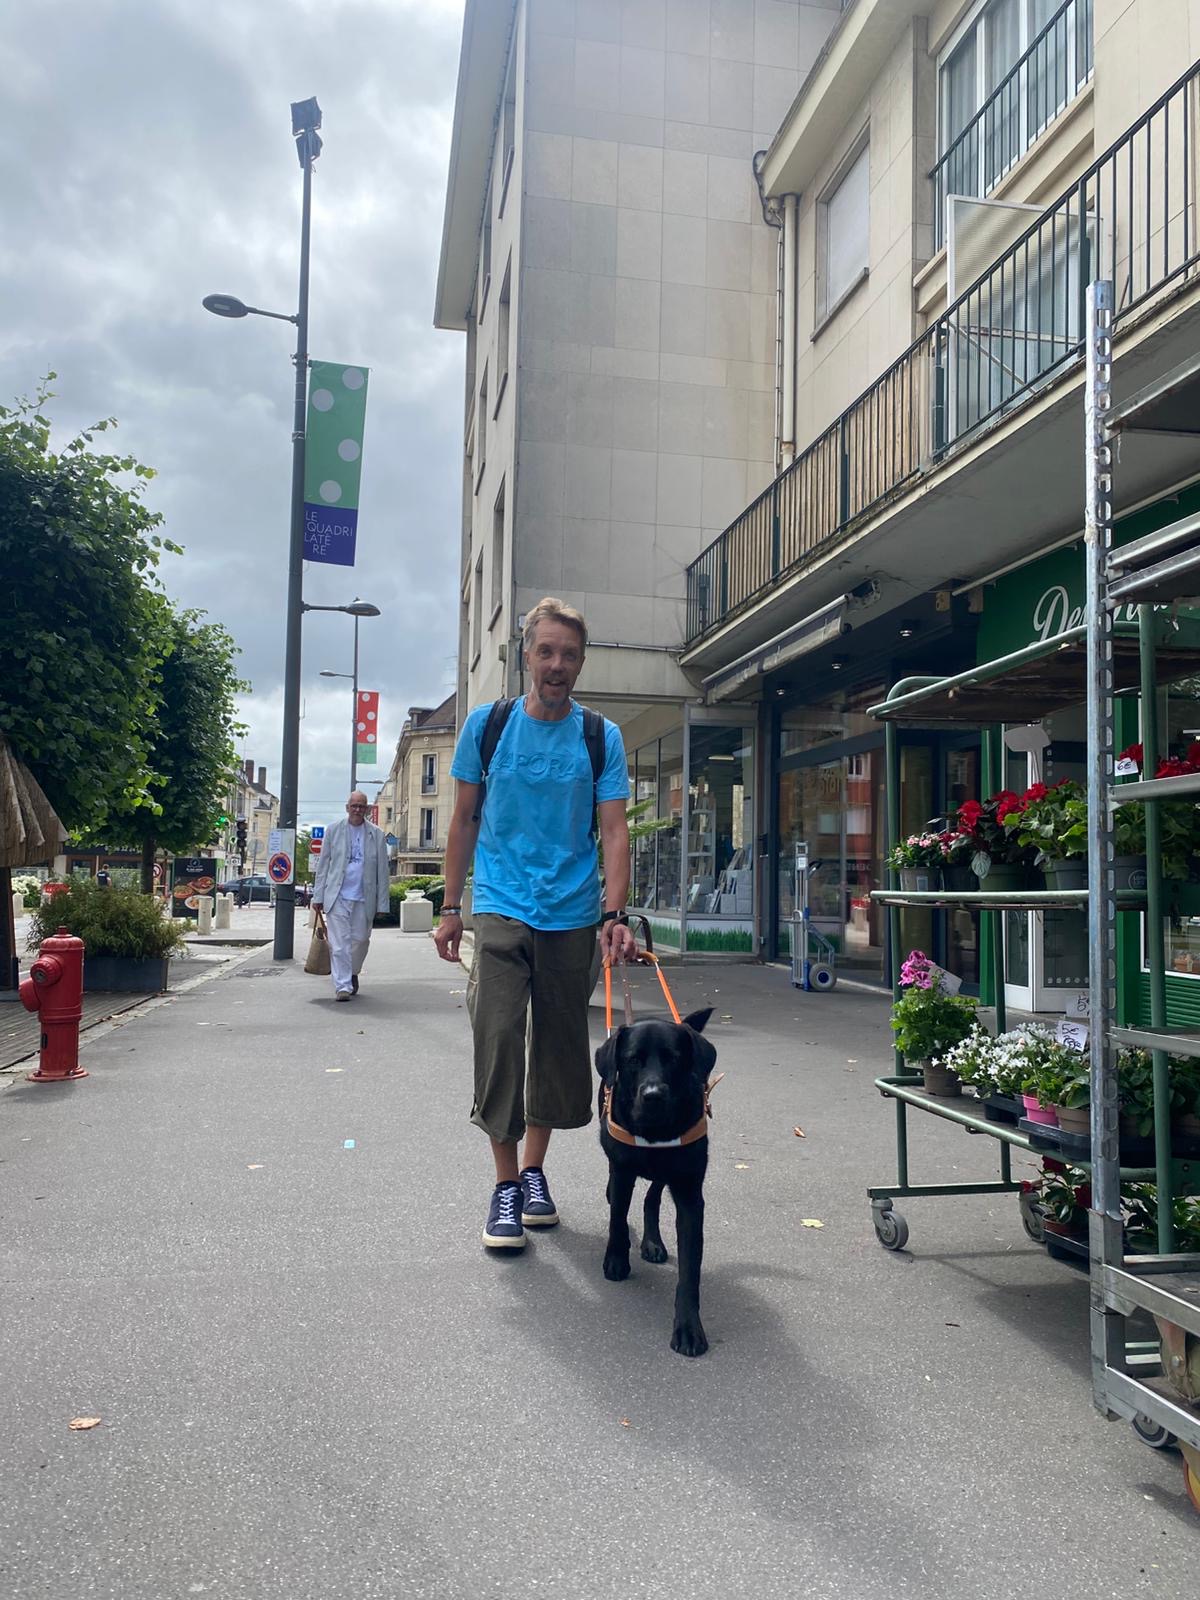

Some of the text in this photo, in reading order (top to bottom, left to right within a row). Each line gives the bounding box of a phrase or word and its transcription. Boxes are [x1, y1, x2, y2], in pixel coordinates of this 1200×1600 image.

[305, 511, 317, 522] LE
[306, 521, 353, 537] QUADRI
[312, 543, 326, 556] RE
